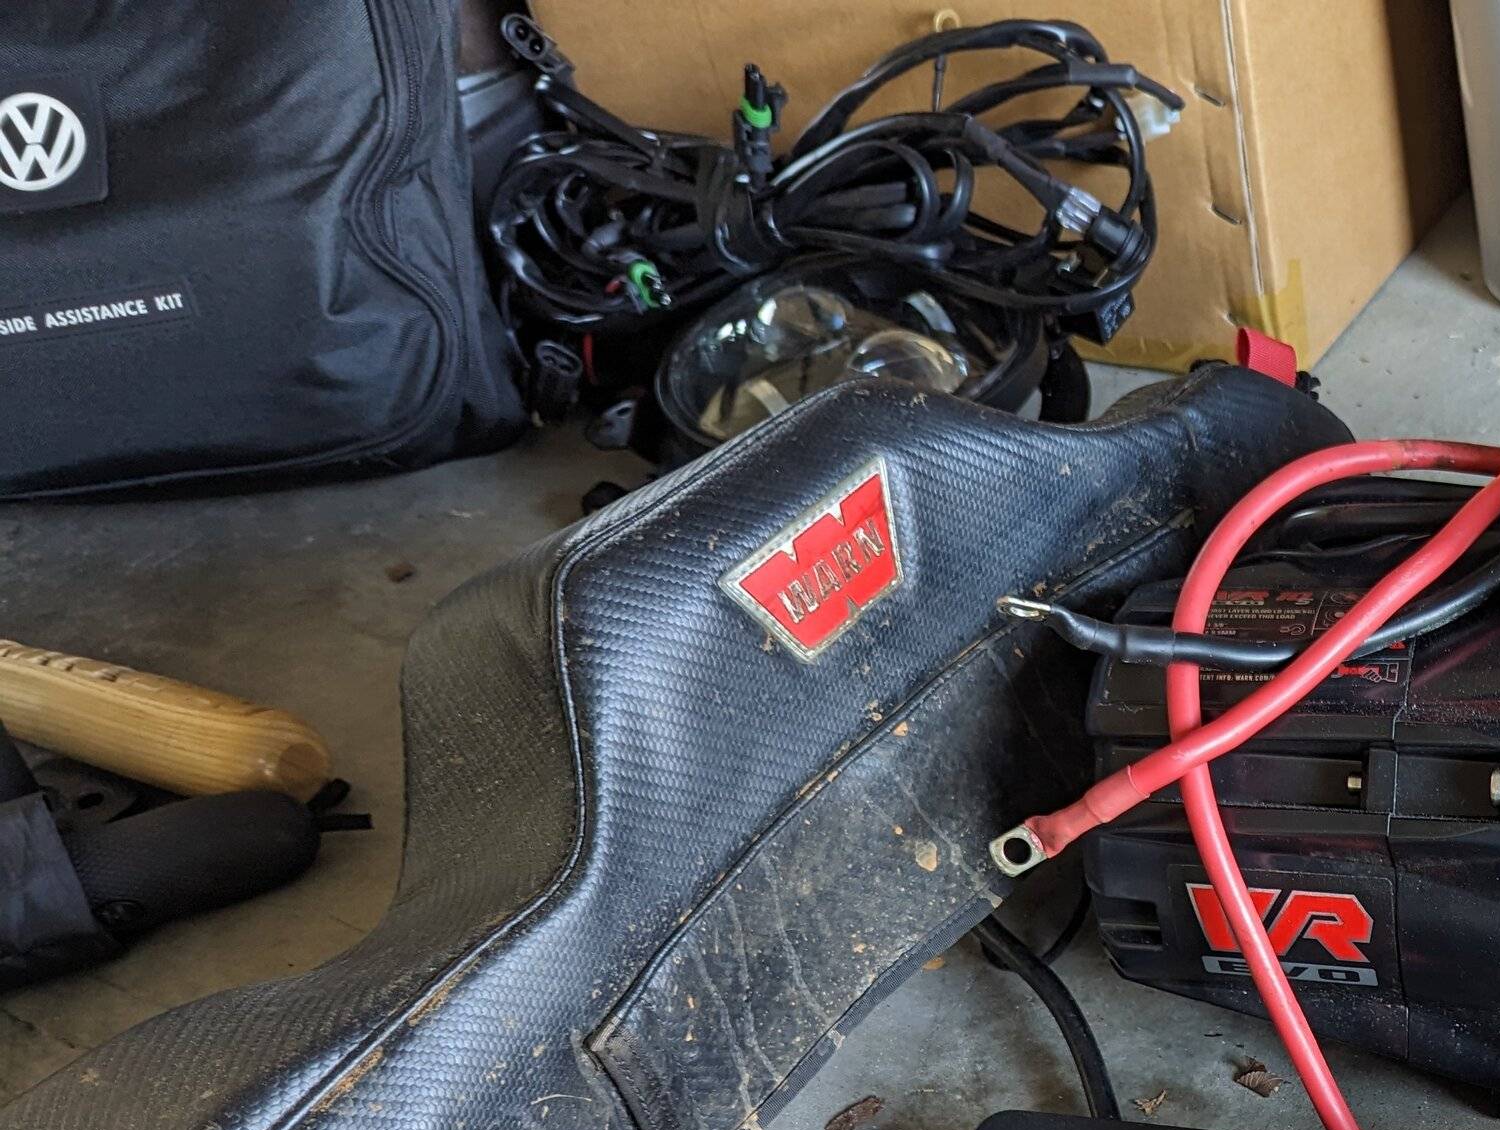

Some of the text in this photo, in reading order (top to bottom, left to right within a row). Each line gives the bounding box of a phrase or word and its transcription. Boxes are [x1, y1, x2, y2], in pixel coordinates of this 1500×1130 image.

[0, 92, 86, 191] VW
[0, 293, 184, 336] SIDE ASSISTANCE KIT
[777, 518, 886, 624] WARN
